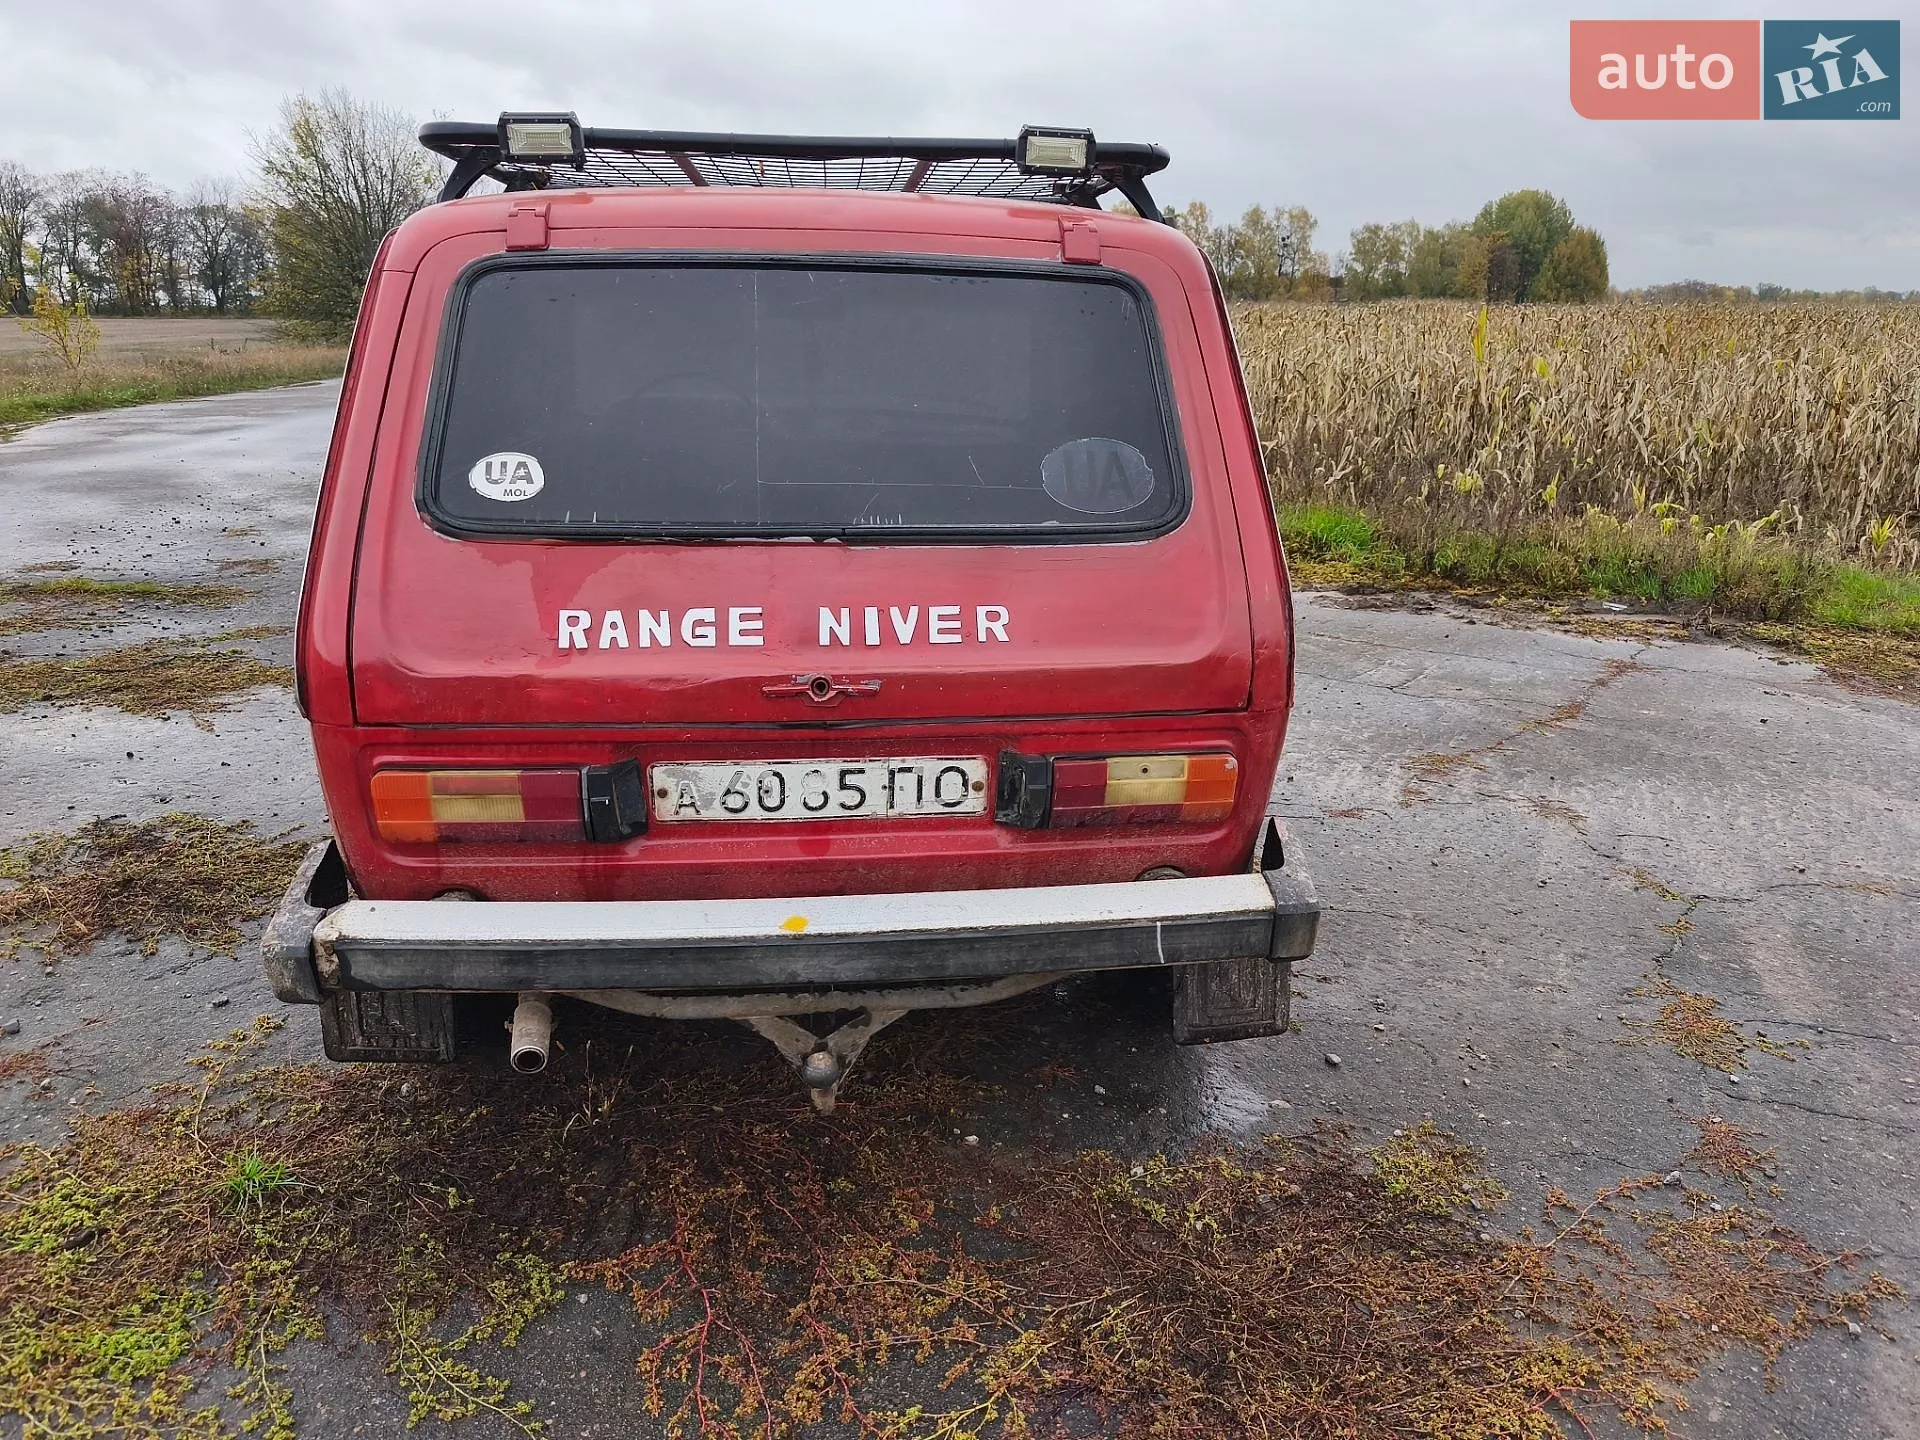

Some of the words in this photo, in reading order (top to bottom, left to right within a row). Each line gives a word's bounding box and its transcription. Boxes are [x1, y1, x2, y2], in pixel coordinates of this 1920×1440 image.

[485, 461, 534, 485] UA
[503, 488, 528, 497] MOL
[557, 606, 765, 649] RANGE
[818, 605, 1010, 646] NIVER
